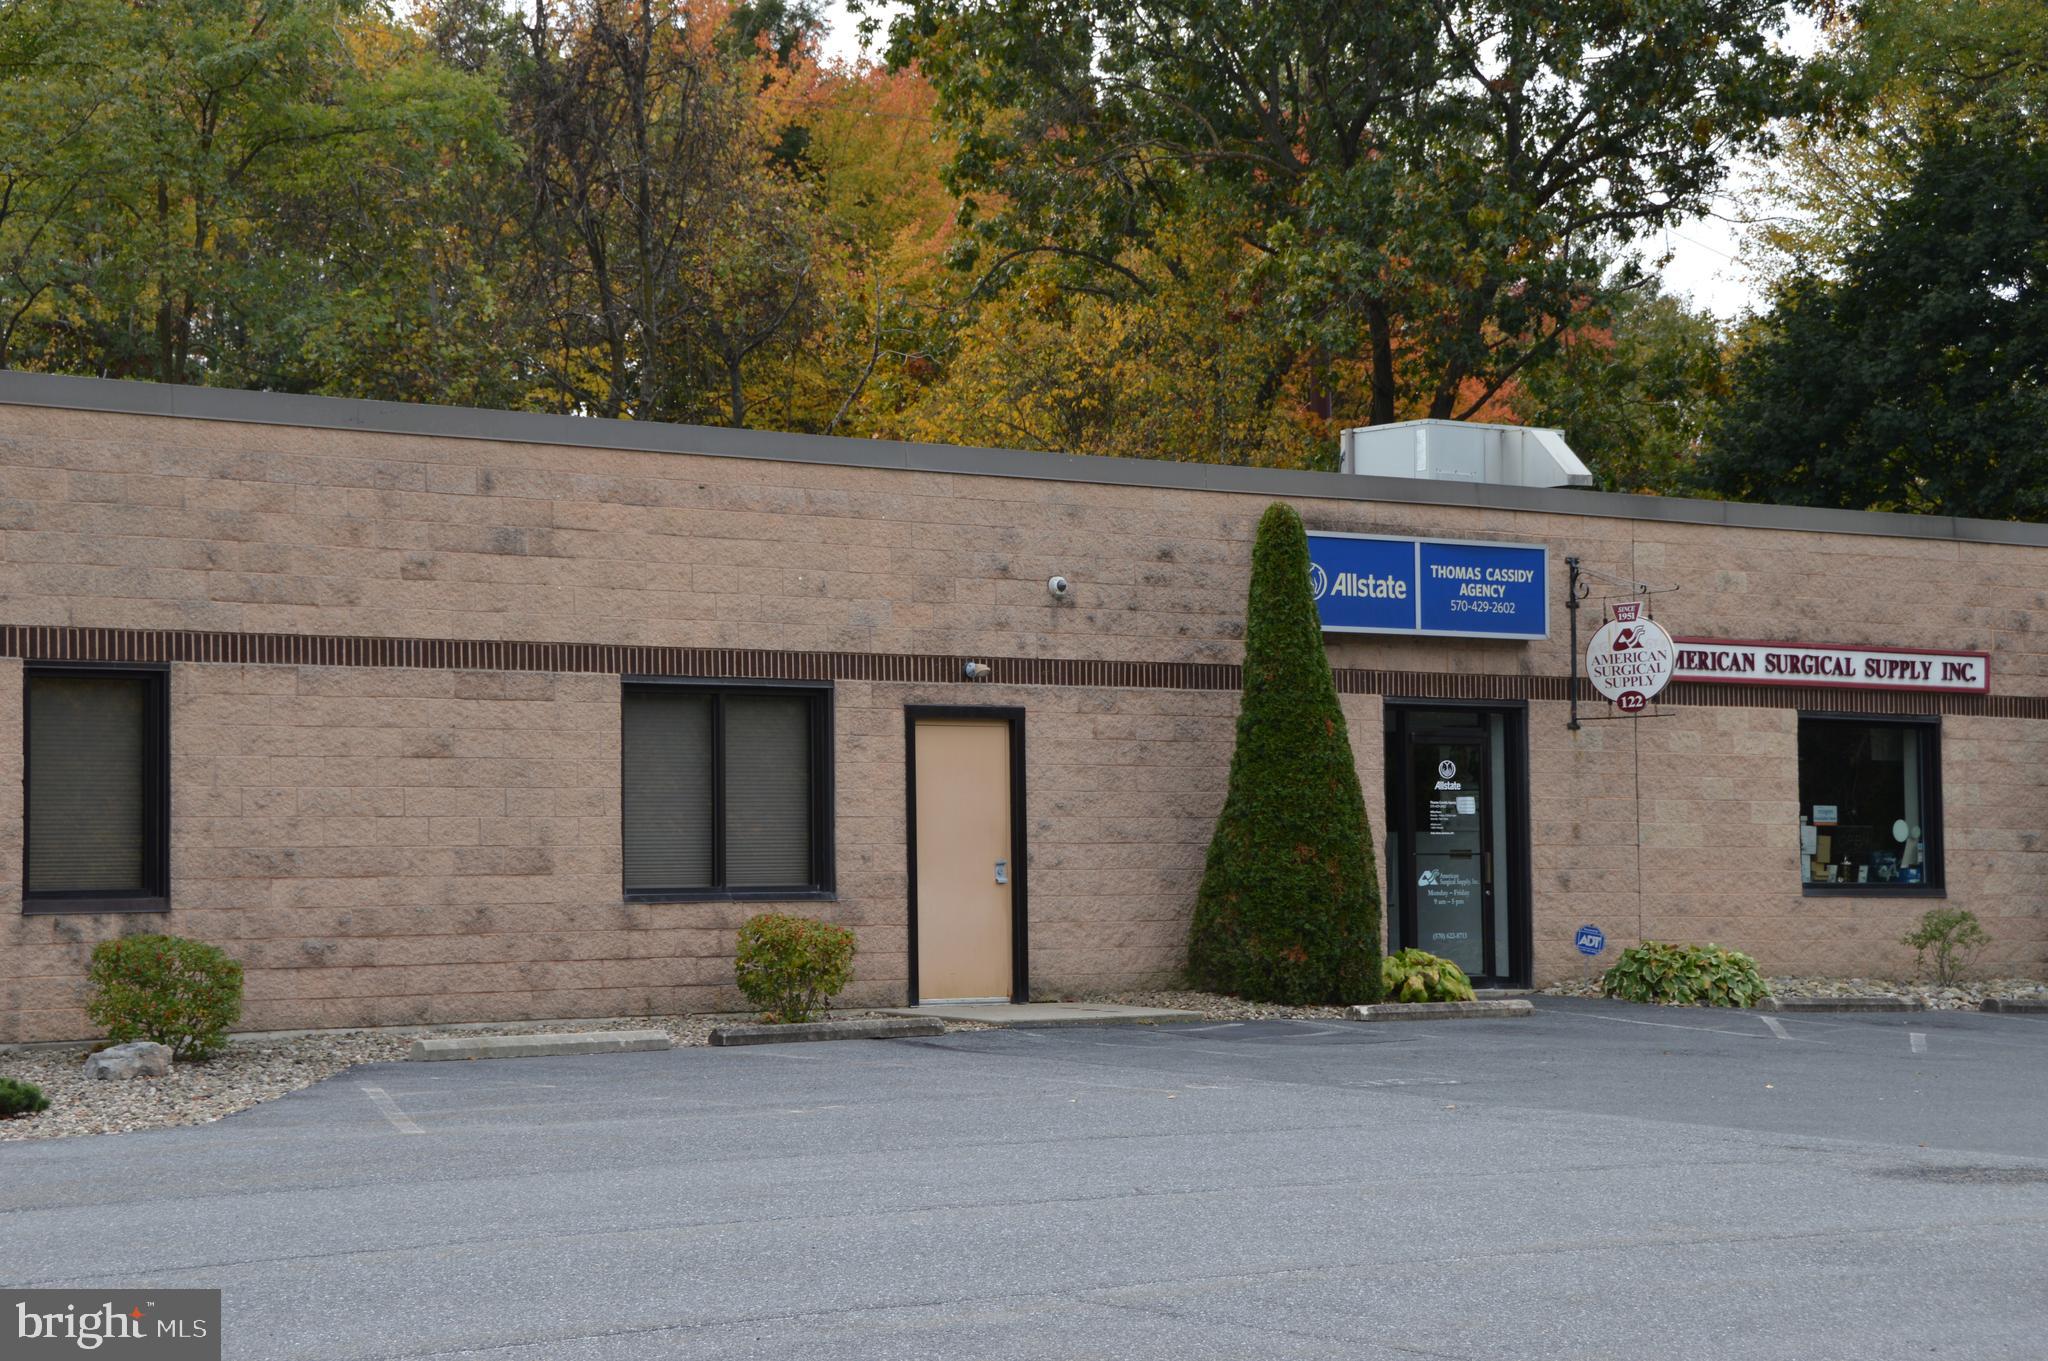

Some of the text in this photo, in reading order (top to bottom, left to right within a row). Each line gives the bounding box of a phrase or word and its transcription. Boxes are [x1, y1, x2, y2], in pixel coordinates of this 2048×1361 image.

[1431, 565, 1534, 583] THOMAS CASSIDY
[1331, 572, 1407, 599] Allstate
[1459, 583, 1506, 598] AGENCY
[1451, 600, 1516, 614] 570-429-2602
[1618, 612, 1635, 621] 1951
[1591, 650, 1667, 666] AMERICAN
[1594, 662, 1666, 678] SURGICAL
[1675, 650, 1977, 682] MERICAN SURGICAL SUPPLY INC.
[1605, 675, 1656, 689] SUPPLY
[1621, 696, 1643, 708] 122
[1434, 780, 1461, 790] Allstate
[1579, 934, 1602, 948] ADT
